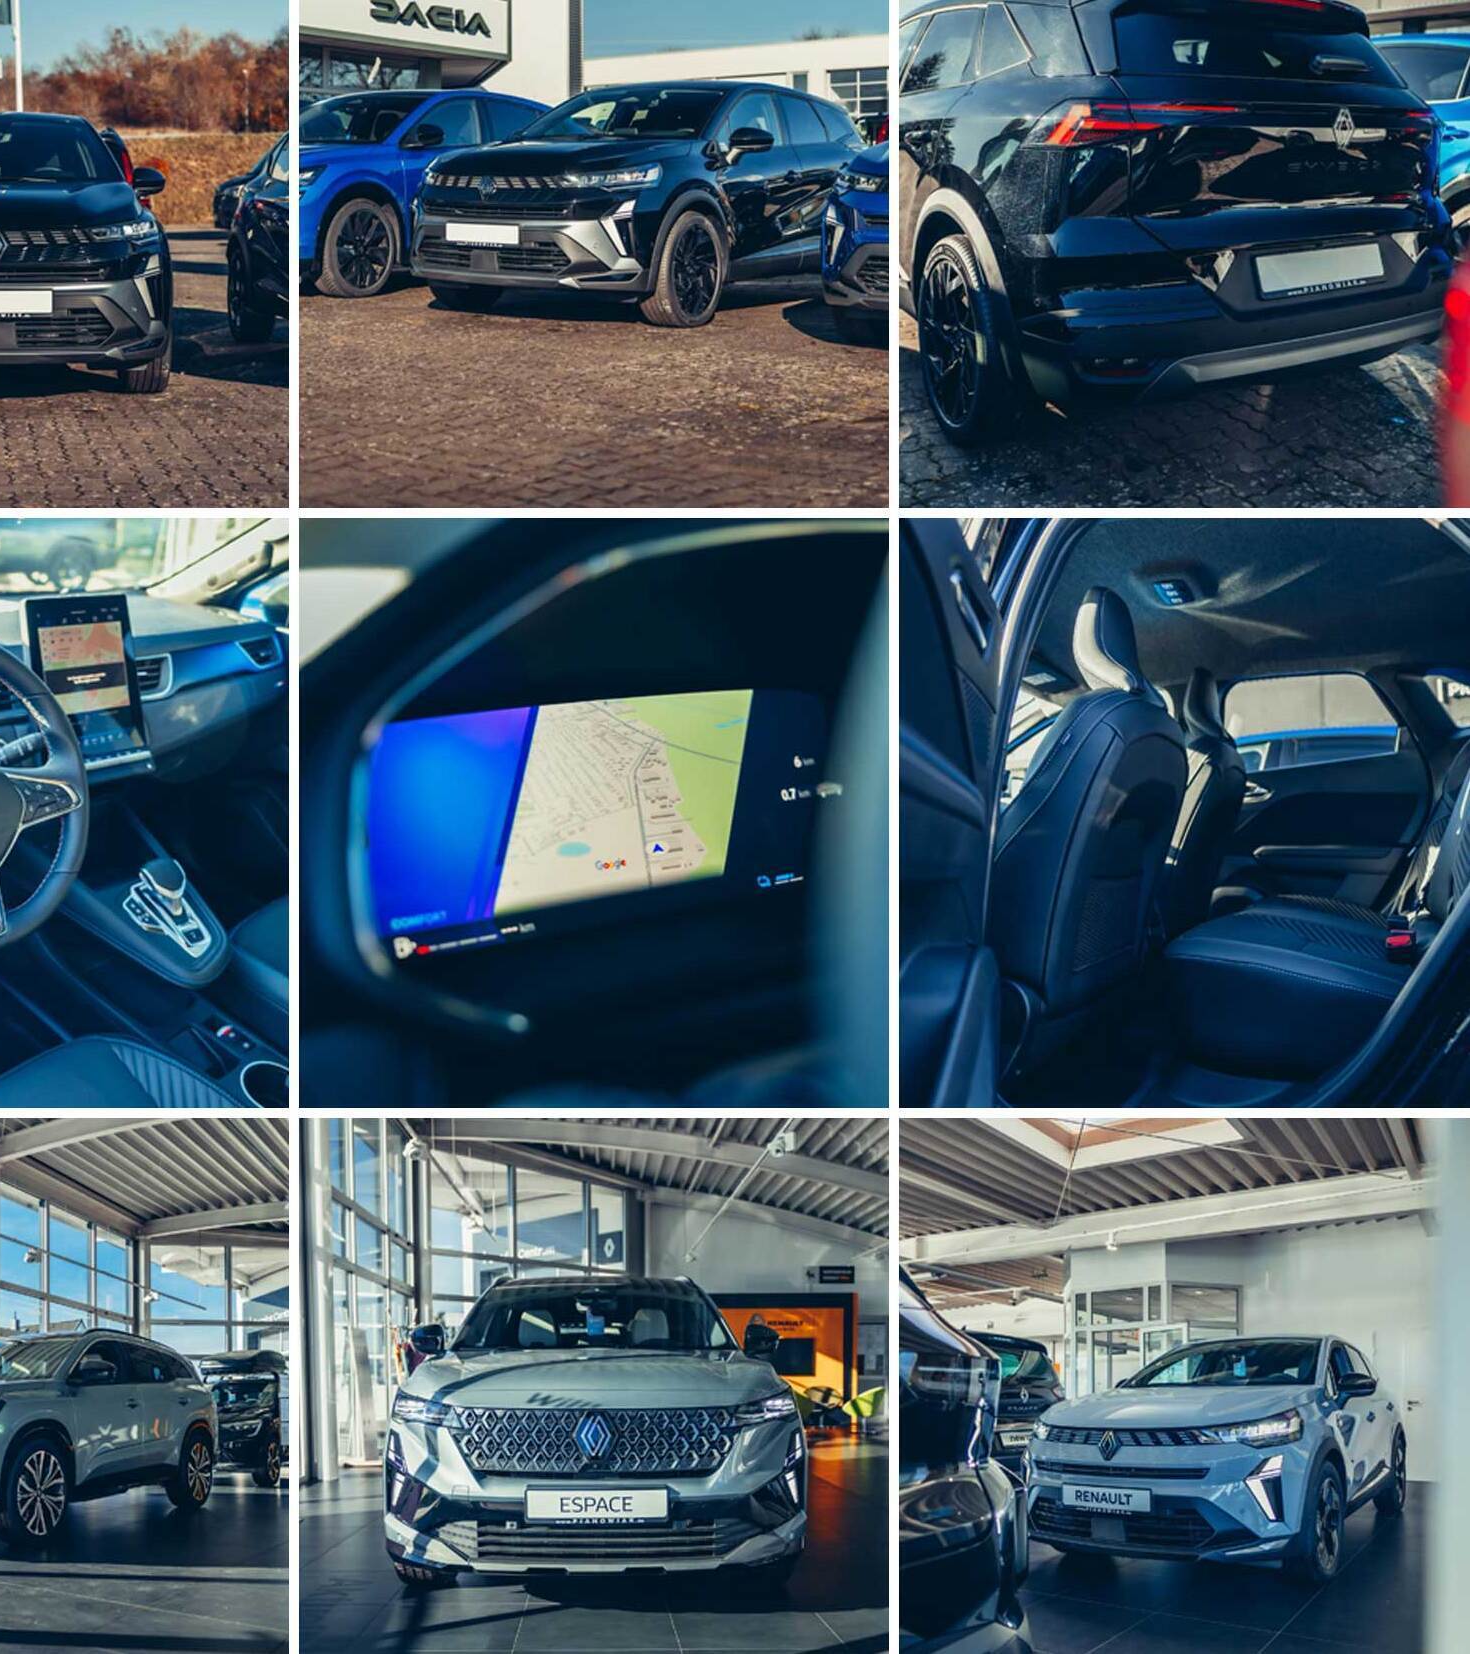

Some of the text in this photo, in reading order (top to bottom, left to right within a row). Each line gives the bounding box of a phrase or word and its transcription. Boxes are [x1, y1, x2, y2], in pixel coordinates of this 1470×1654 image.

[370, 0, 492, 38] DACIA
[560, 1496, 634, 1513] ESPACE
[1075, 1490, 1133, 1505] RENAULT
